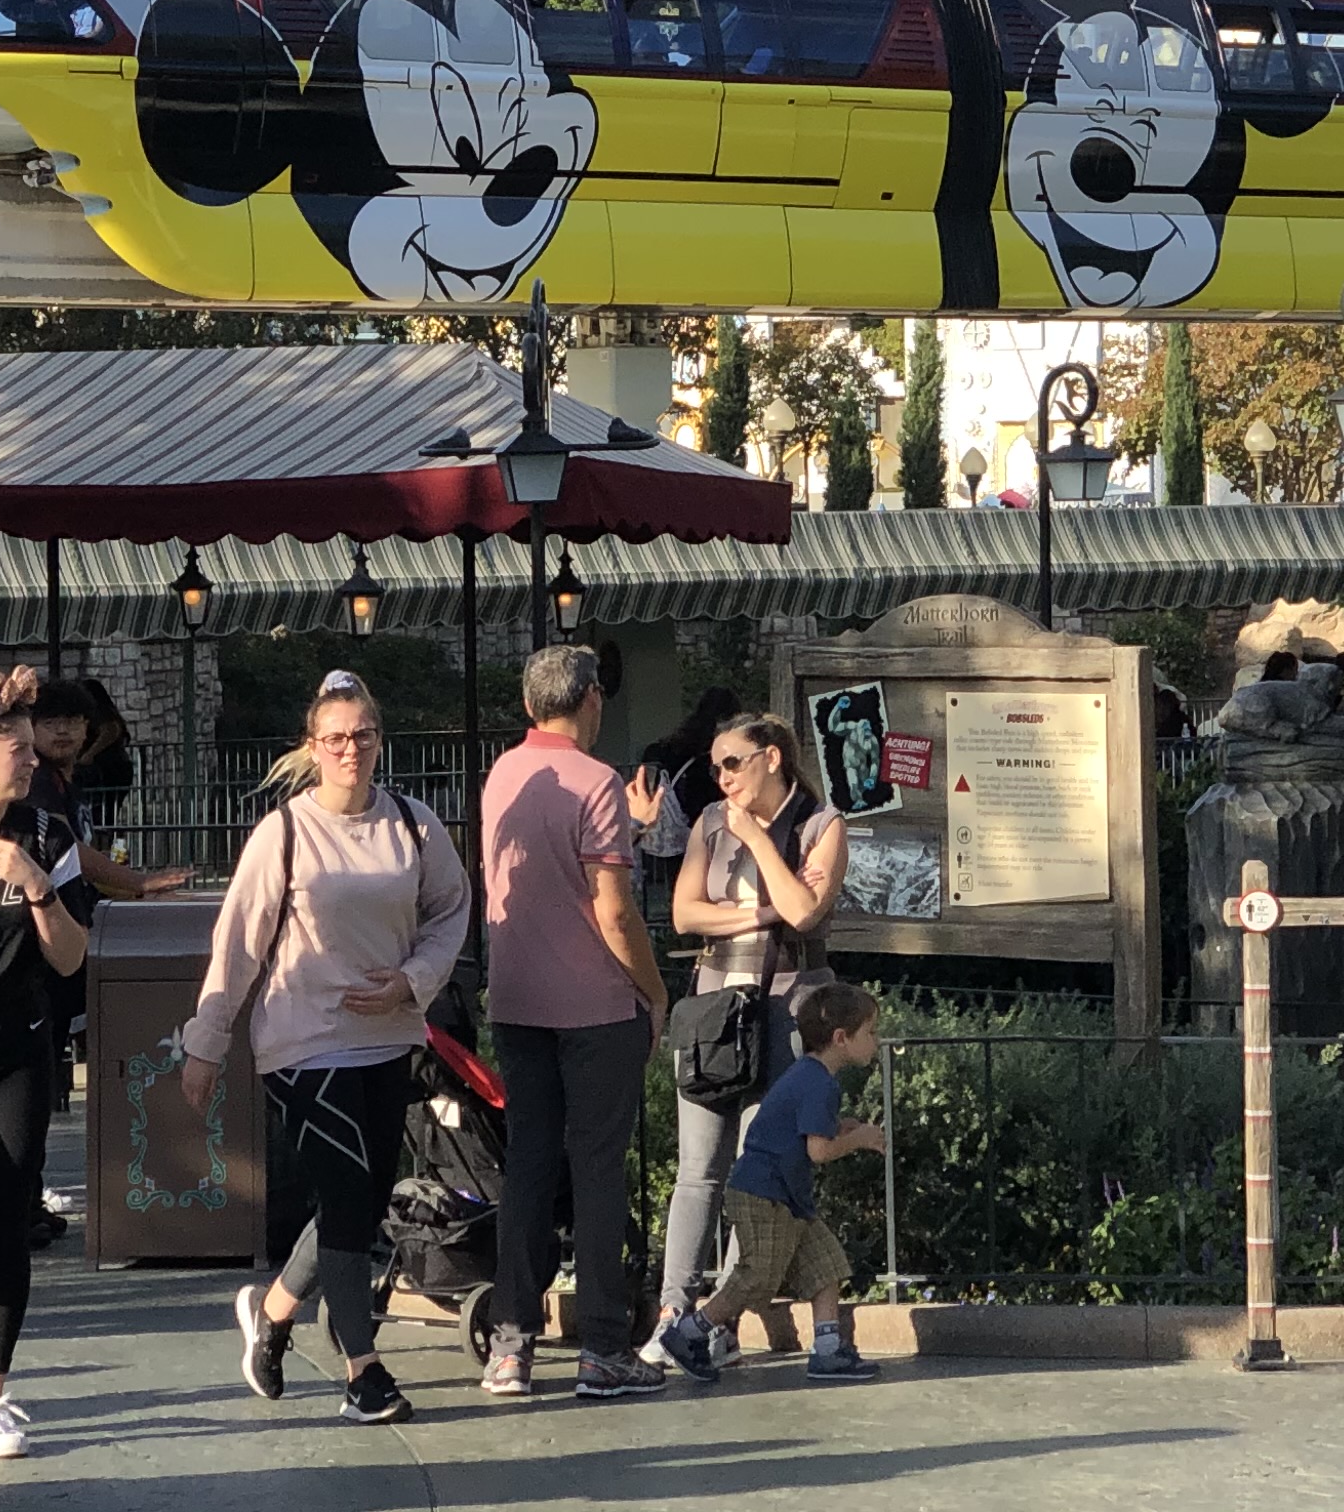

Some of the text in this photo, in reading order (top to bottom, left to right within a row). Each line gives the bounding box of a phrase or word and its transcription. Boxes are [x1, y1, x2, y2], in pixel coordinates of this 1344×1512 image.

[903, 602, 1000, 625] Matterhorn
[934, 625, 968, 647] Trail
[996, 758, 1056, 769] WARNING!
